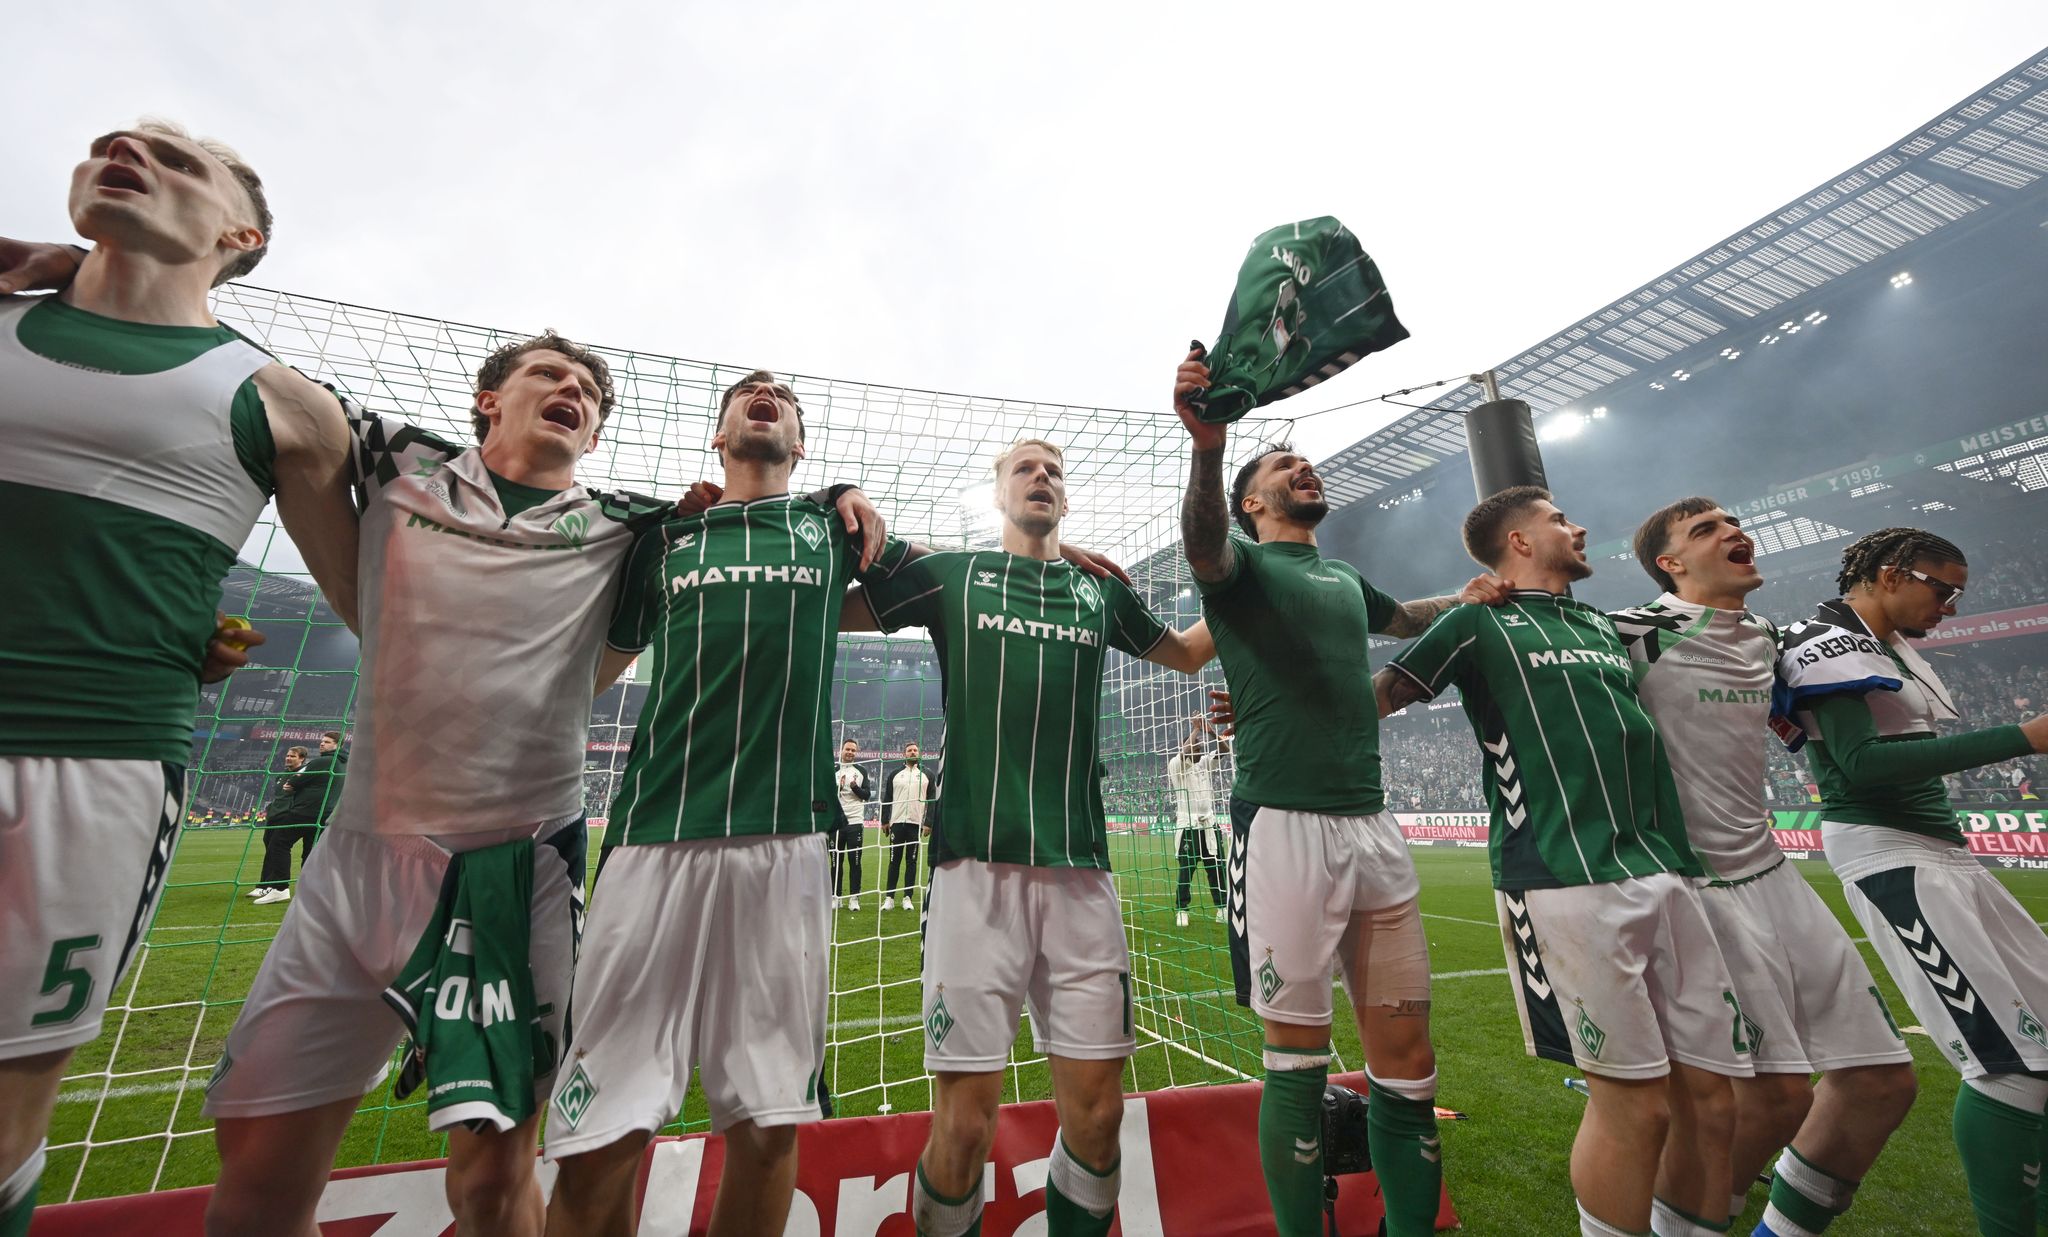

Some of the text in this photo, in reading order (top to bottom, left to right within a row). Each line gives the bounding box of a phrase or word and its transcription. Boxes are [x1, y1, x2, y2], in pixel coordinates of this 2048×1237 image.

[1842, 465, 1883, 487] 1992
[672, 565, 822, 595] MATTHÄI
[977, 613, 1098, 648] MATTHÄI
[1979, 620, 2010, 633] als
[1528, 649, 1632, 676] MATTHÄ
[1408, 826, 1476, 839] KATTELMANN
[1962, 833, 2048, 853] TELM
[30, 934, 103, 1027] 5
